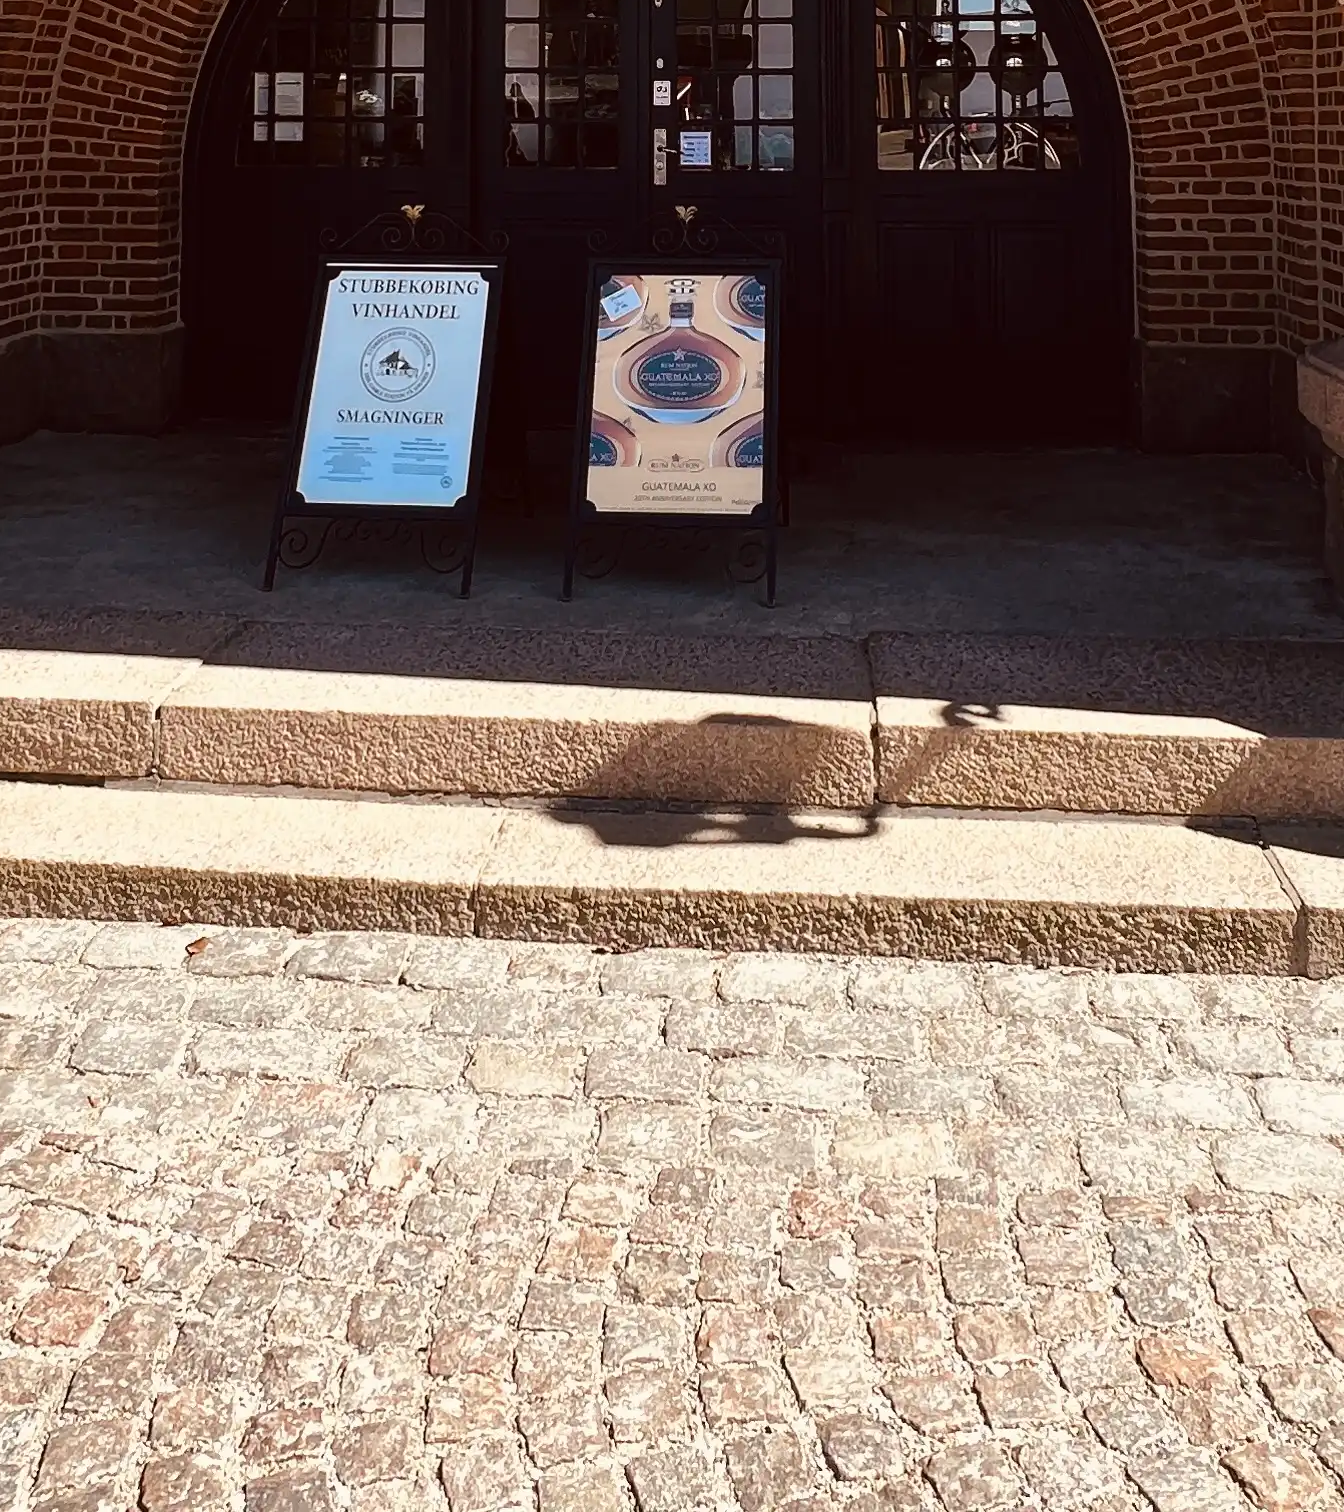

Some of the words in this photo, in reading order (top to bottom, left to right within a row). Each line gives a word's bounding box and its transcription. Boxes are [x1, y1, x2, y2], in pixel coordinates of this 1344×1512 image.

[338, 278, 480, 295] STUBBEKØBING
[351, 303, 461, 319] VINHANDEL
[640, 372, 702, 382] GUATEMALA
[336, 409, 444, 425] SMAGNINGER
[641, 481, 701, 492] GUATEMALA
[702, 481, 717, 492] XO
